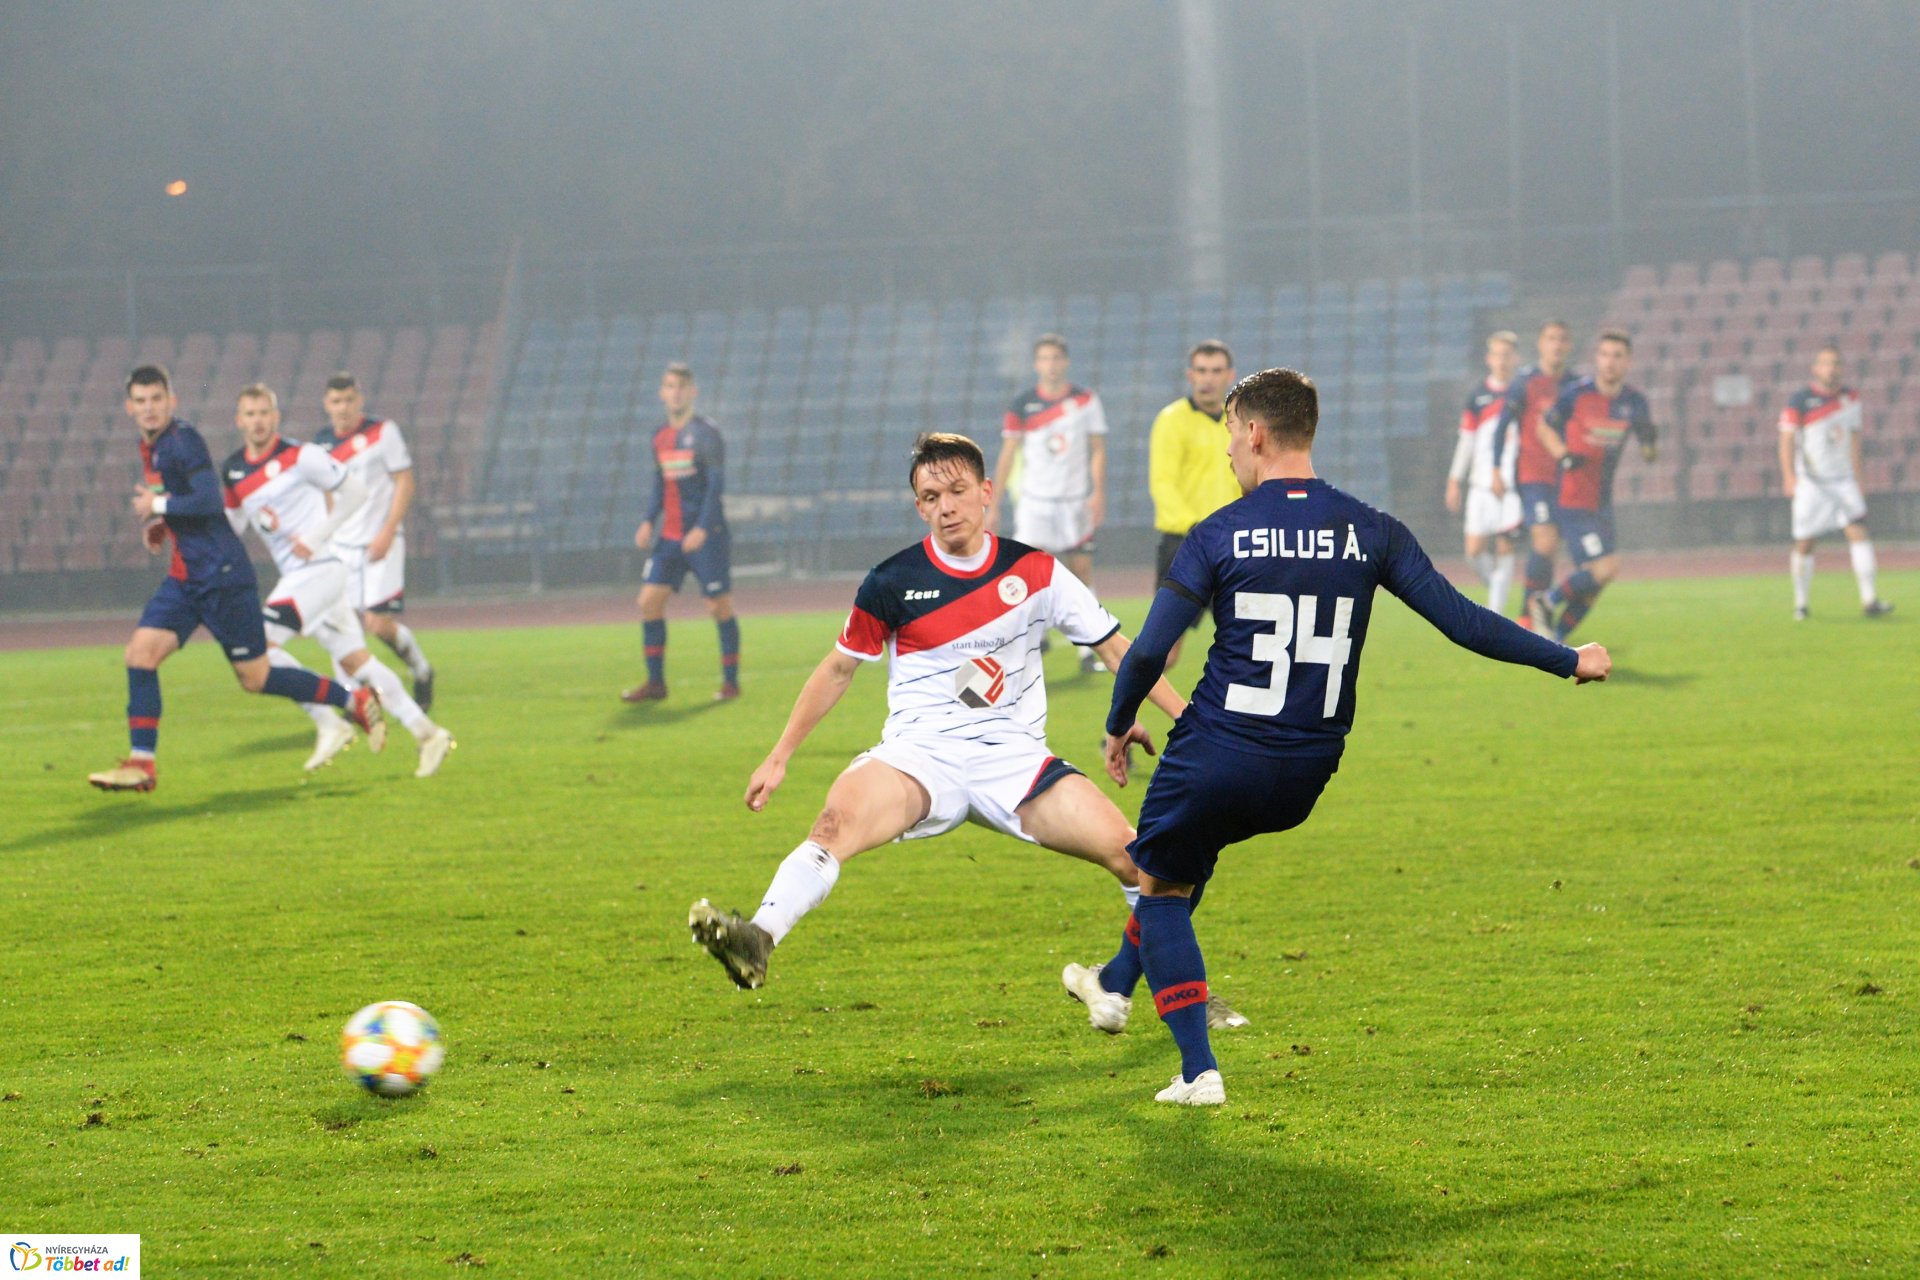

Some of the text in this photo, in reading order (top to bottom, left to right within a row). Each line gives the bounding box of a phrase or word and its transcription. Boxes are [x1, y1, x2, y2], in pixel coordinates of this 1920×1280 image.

[1233, 528, 1334, 559] CSILUS
[904, 589, 940, 600] Zeus
[1224, 591, 1354, 719] 34
[1161, 988, 1199, 1006] JAKO
